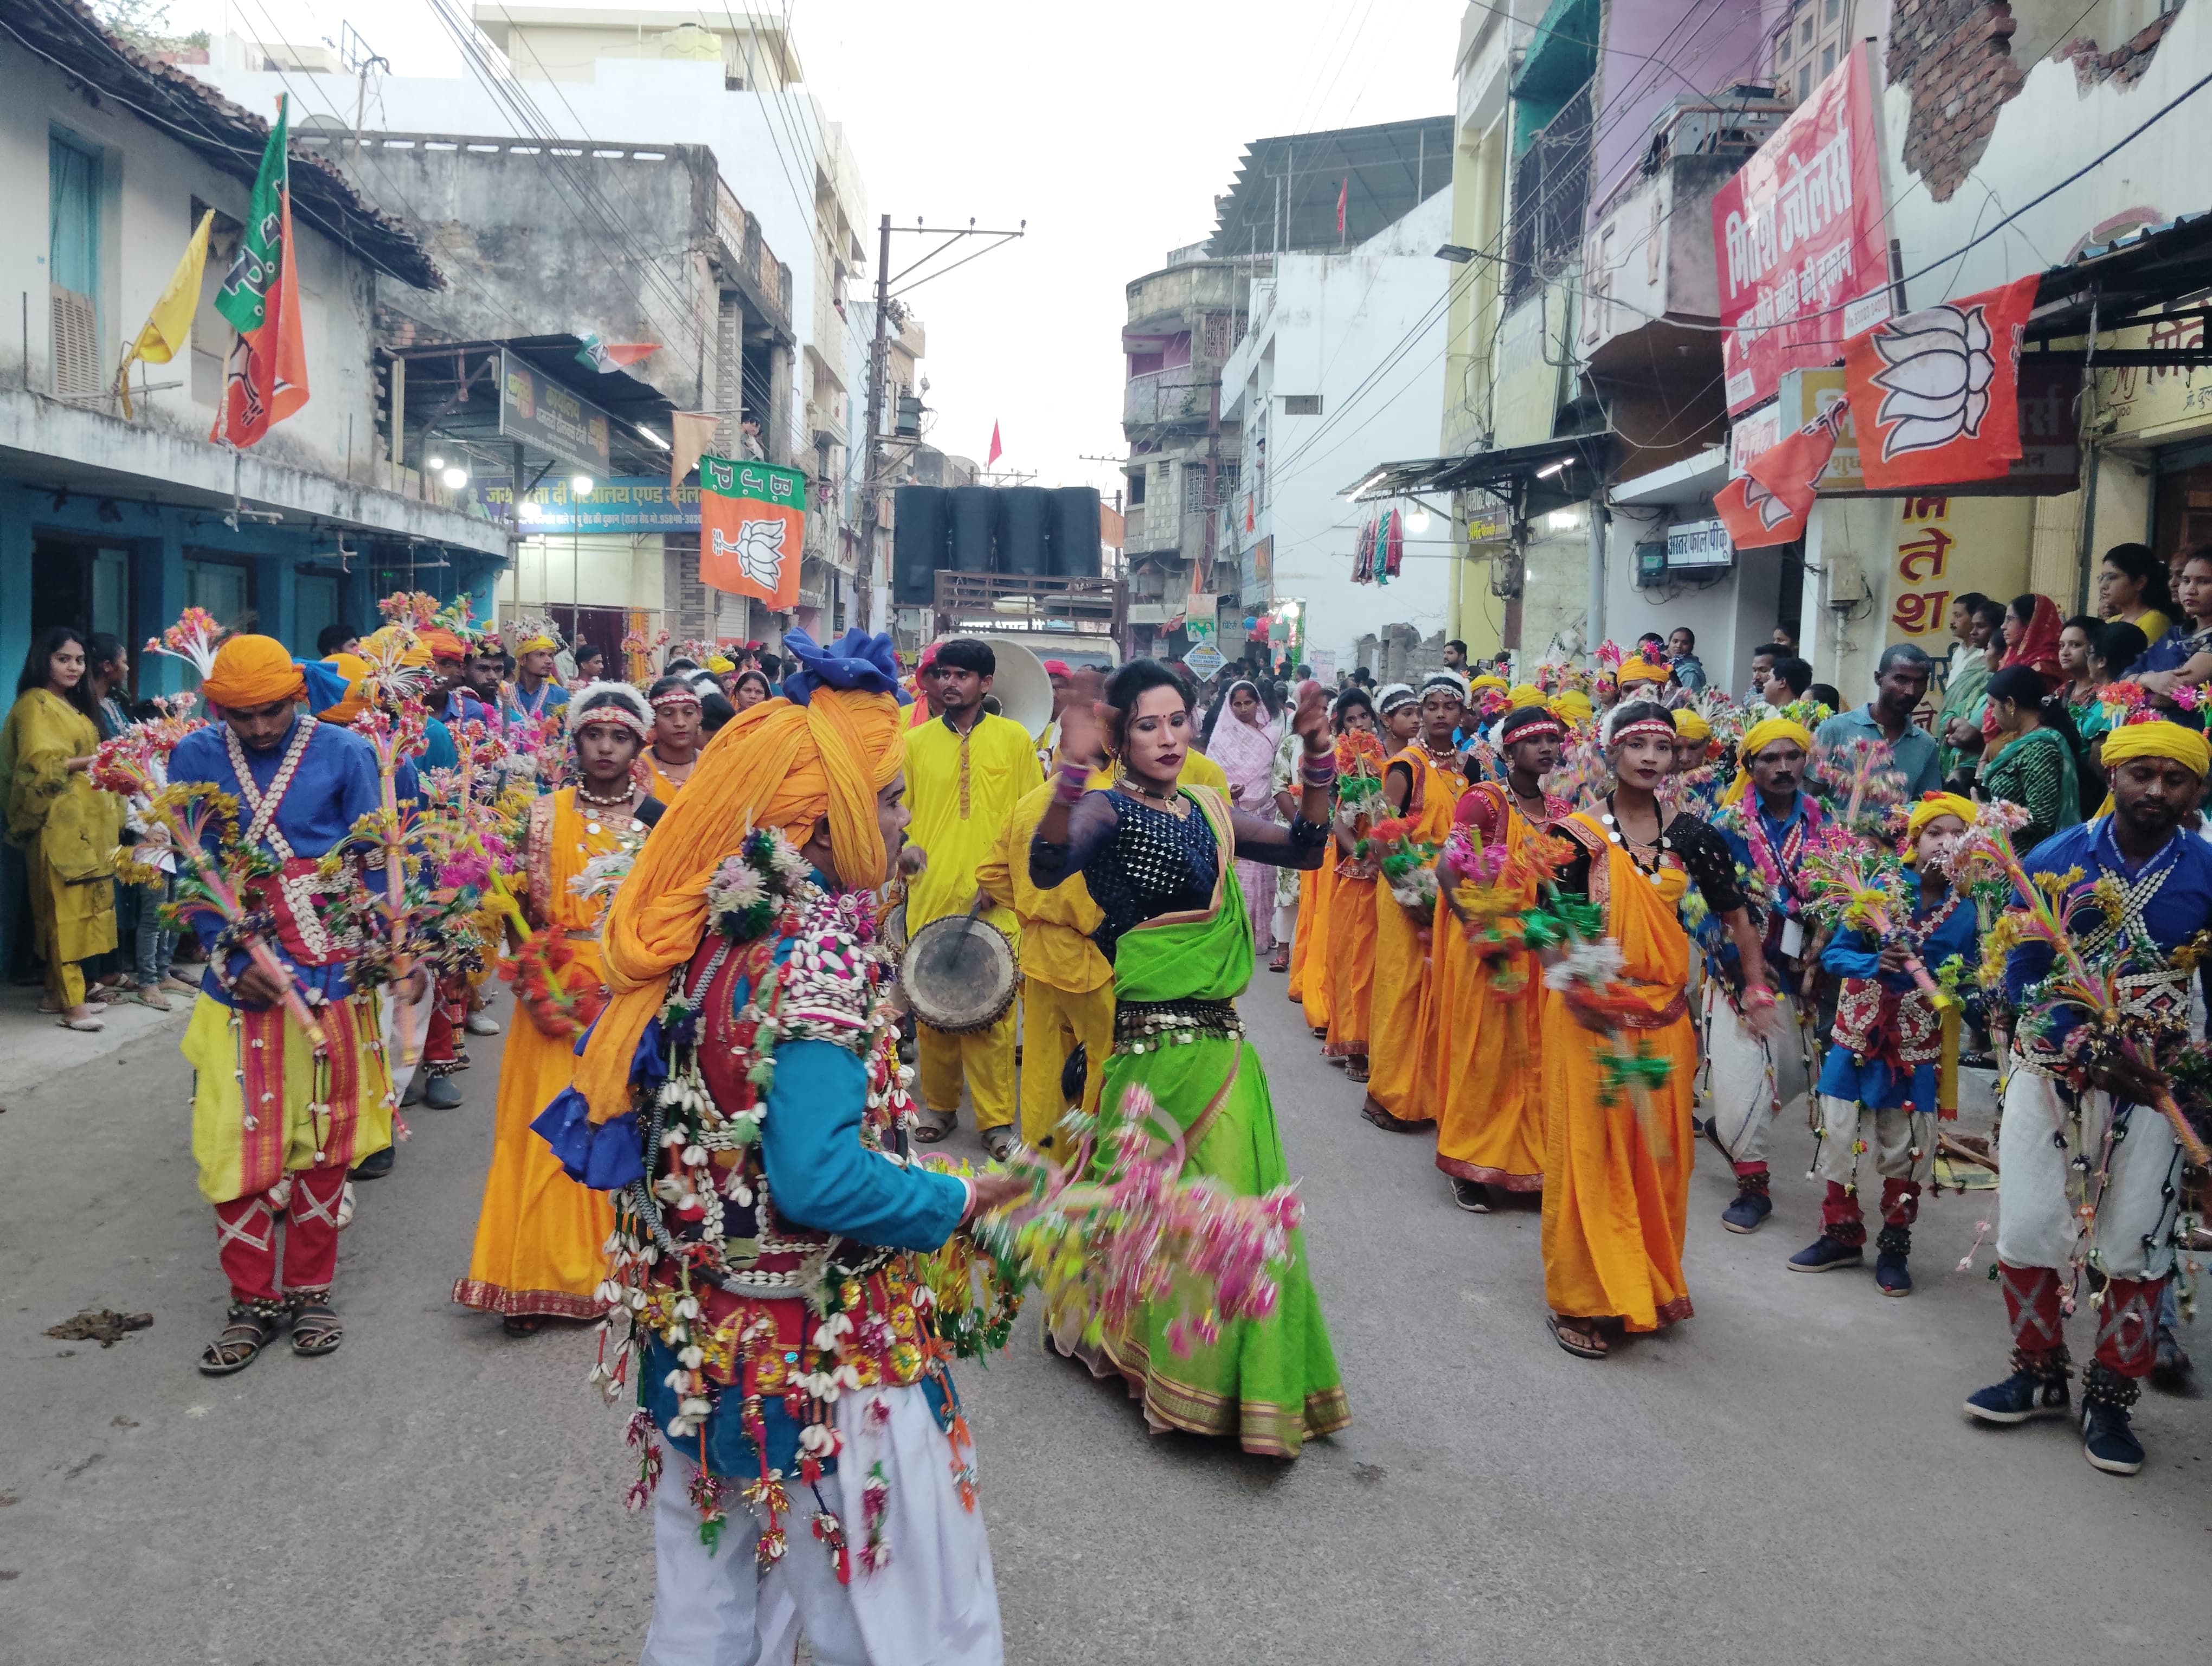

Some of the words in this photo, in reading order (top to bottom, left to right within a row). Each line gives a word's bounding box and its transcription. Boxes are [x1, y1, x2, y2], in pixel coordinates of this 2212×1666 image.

[1726, 193, 1778, 299] मितेश
[1778, 98, 1853, 253] ज्वेलर्स
[1799, 255, 1817, 305] की
[1817, 238, 1853, 307] दुकान
[553, 481, 567, 506] दी
[633, 486, 663, 507] एण्ड
[1668, 534, 1688, 555] अस्तर
[1689, 531, 1708, 554] फाल
